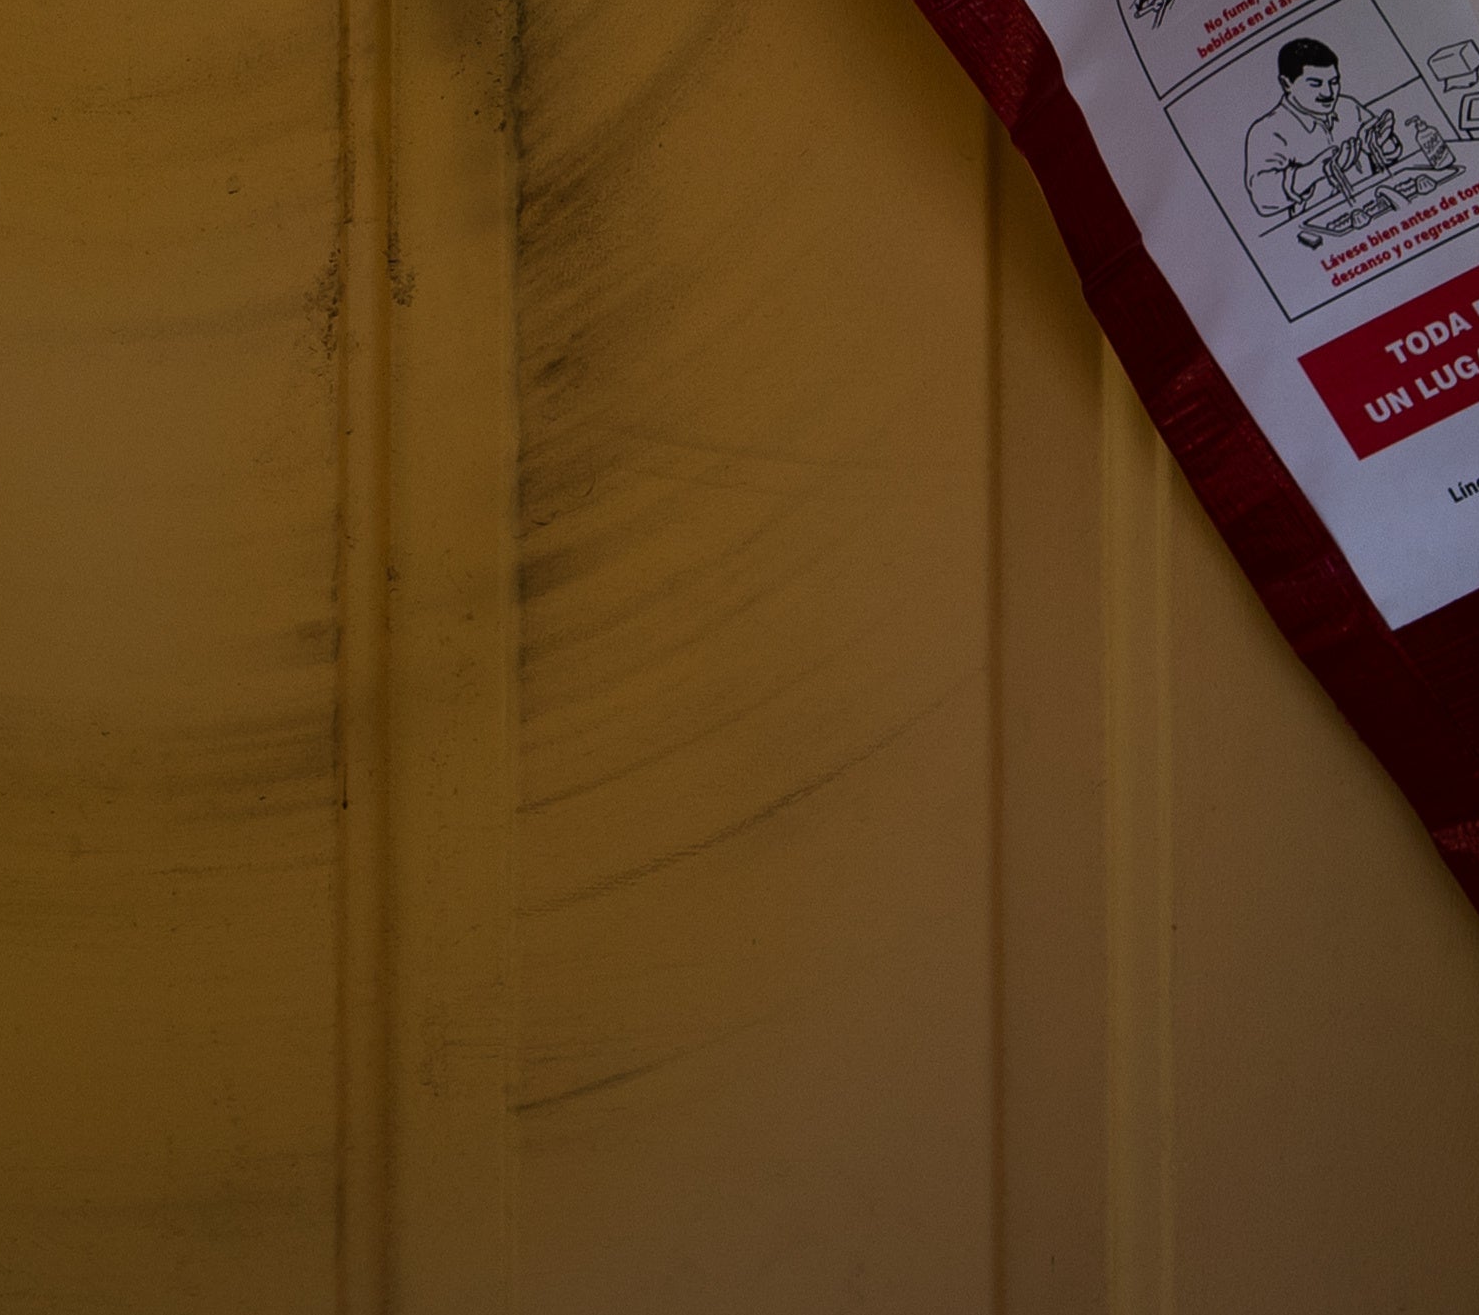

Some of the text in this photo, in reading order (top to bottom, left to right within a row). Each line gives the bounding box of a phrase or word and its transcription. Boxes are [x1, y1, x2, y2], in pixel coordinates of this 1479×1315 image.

[1320, 241, 1368, 271] Lávese
[1366, 225, 1400, 247] bien
[1399, 205, 1438, 230] antes
[1438, 195, 1458, 211] de
[1330, 250, 1391, 287] descanso
[1391, 243, 1402, 258] y
[1402, 239, 1413, 249] o
[1413, 209, 1469, 244] regresar
[1383, 310, 1473, 364] TODA
[1362, 384, 1414, 423] UN
